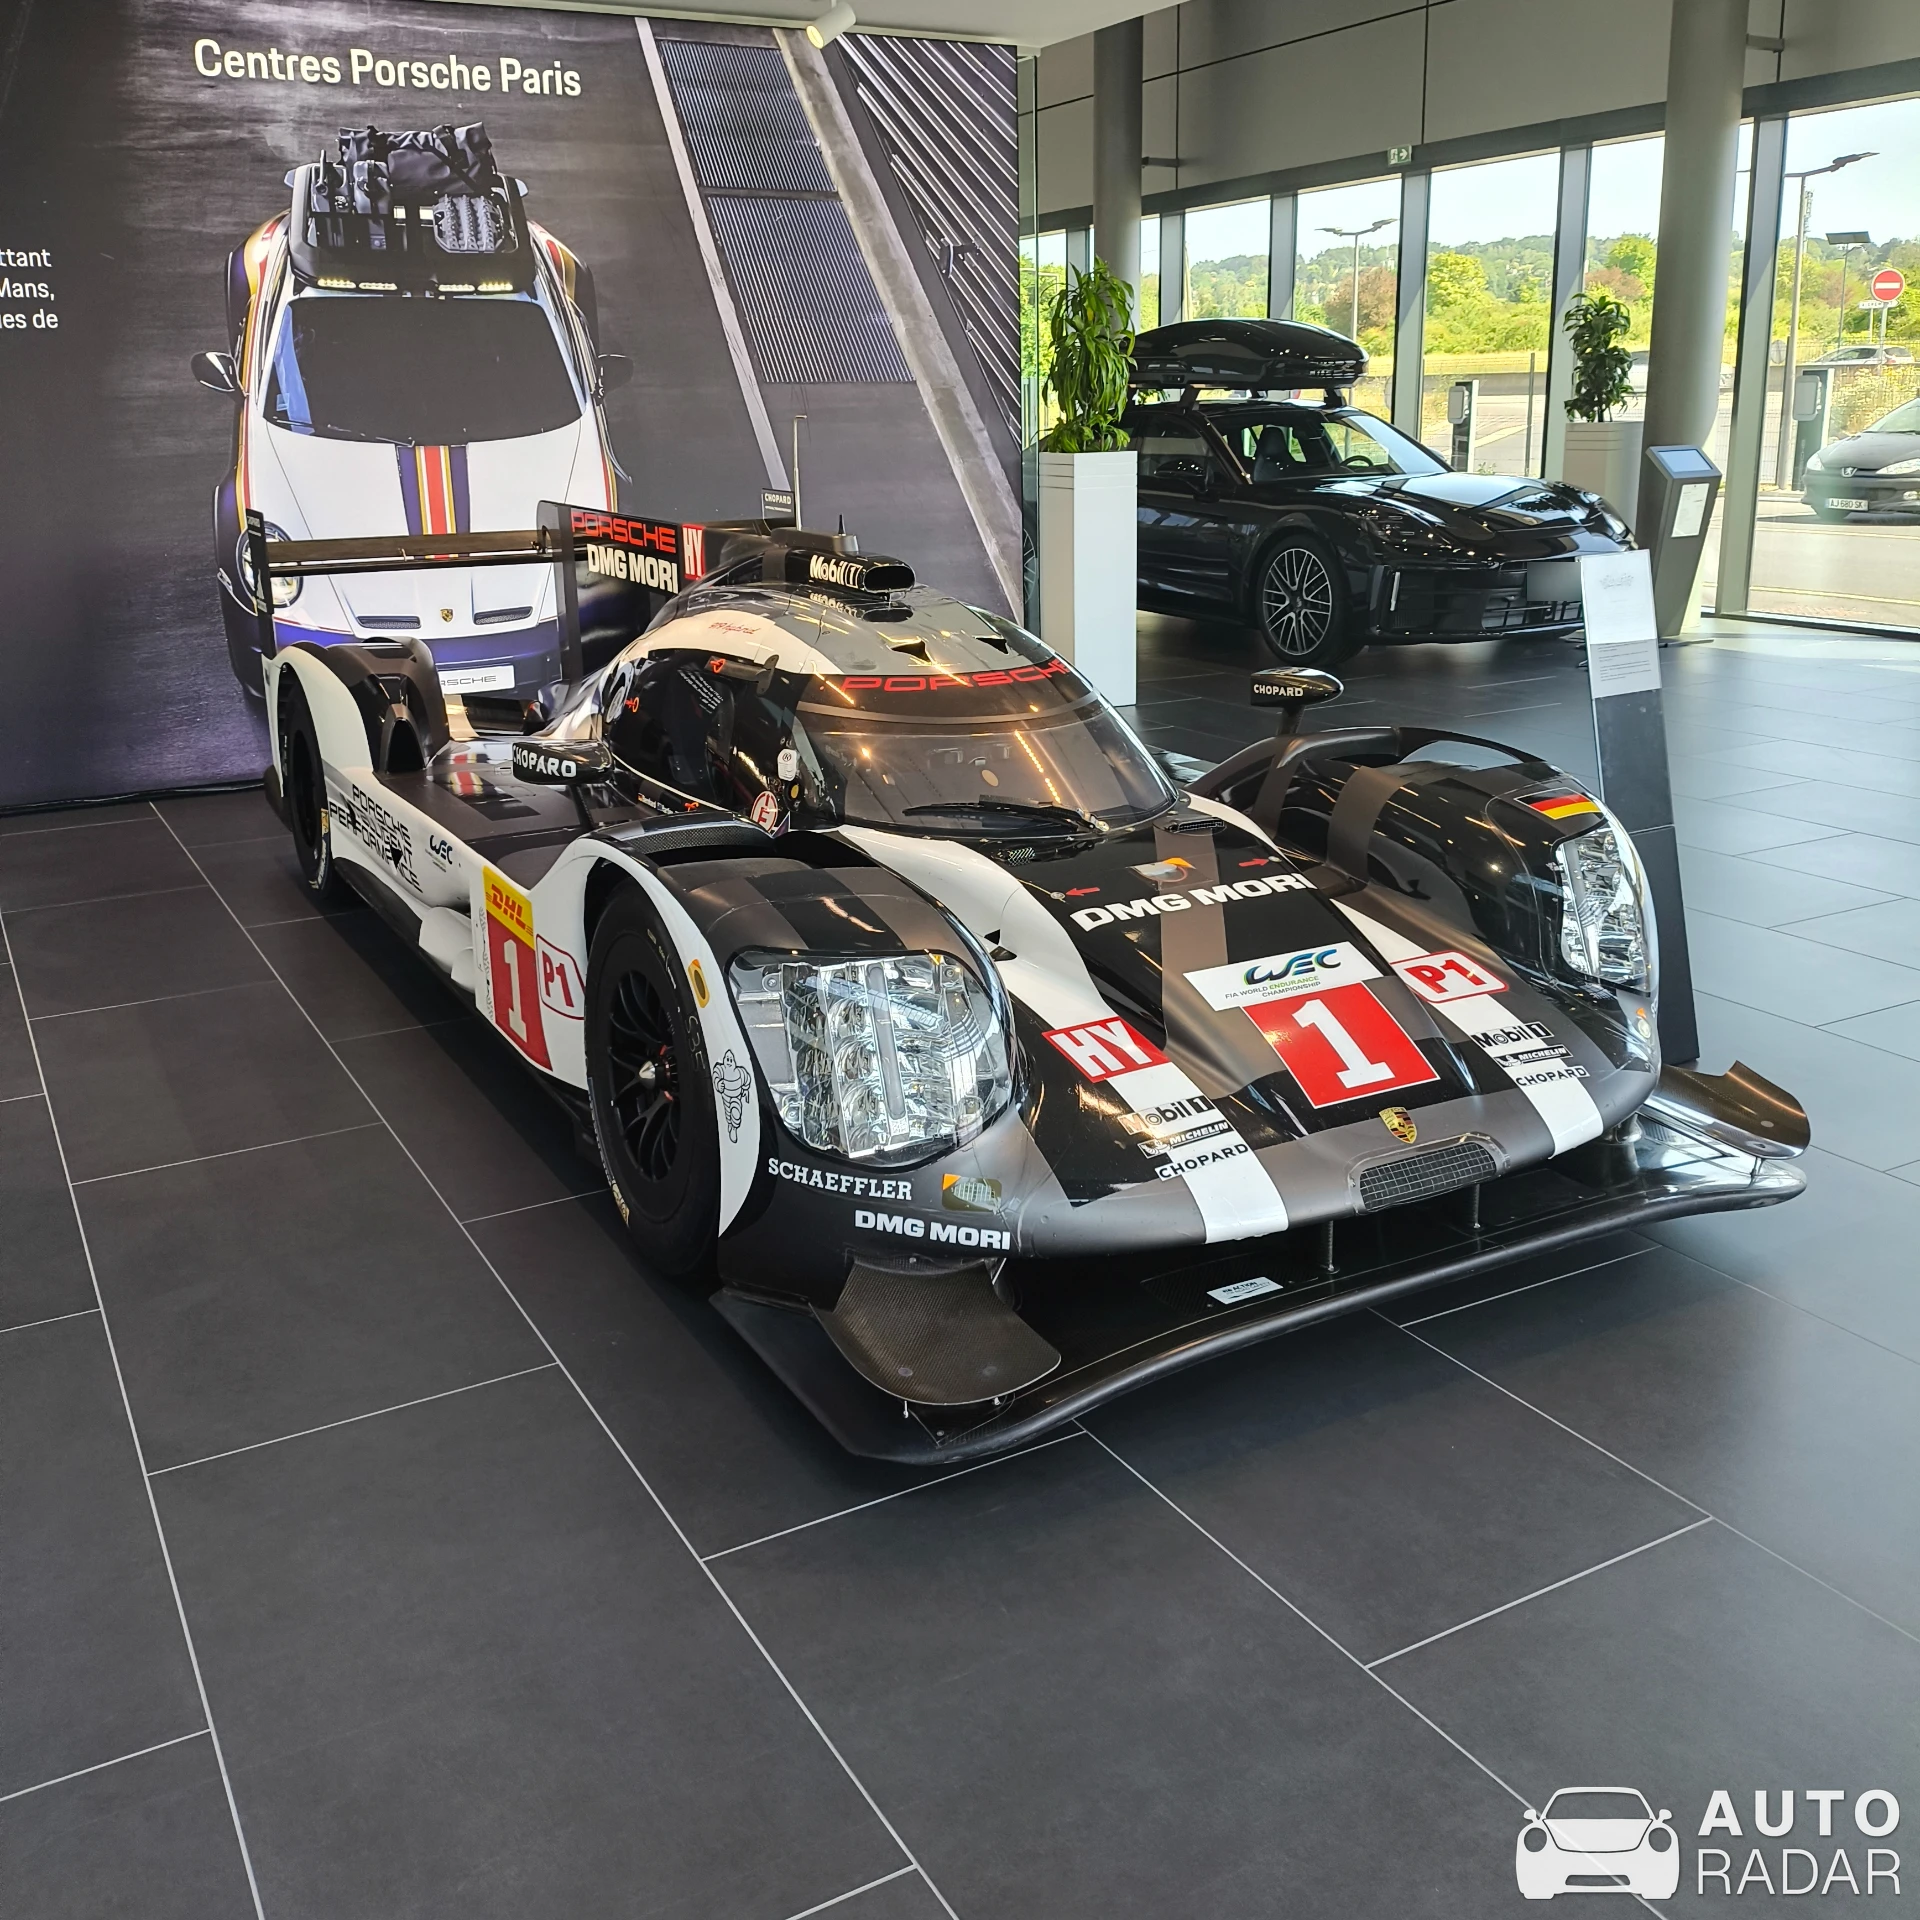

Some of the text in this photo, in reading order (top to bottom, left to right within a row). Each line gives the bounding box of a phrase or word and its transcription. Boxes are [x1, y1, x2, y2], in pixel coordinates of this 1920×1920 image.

[193, 38, 582, 97] Centres Porsche Paris
[0, 308, 59, 329] es de
[571, 510, 676, 553] PORSCHE
[586, 543, 679, 594] DMG MORI
[682, 527, 703, 577] HY
[810, 554, 848, 585] Mobil
[841, 659, 1070, 692] PORSCHE
[1253, 684, 1304, 697] CHOPARD
[352, 784, 412, 848] PORSCHE
[490, 883, 526, 931] DHL
[1069, 873, 1318, 932] DMG MORI
[541, 950, 575, 1008] P1
[1240, 986, 1268, 996] WORLD
[1269, 975, 1320, 990] ENDURANCE
[1243, 948, 1341, 986] WEC
[1404, 959, 1487, 994] P1
[503, 938, 527, 1043] 1
[1261, 981, 1321, 998] CHAMPIONSHIP
[1049, 1019, 1152, 1078] HY
[1291, 998, 1396, 1089] 1
[1471, 1024, 1533, 1048] Mobil
[1518, 1047, 1567, 1062] MICHELIN
[1515, 1067, 1587, 1087] CHOPARD
[1118, 1101, 1192, 1134] Mobil
[1168, 1121, 1229, 1145] MICHELIN
[767, 1157, 912, 1201] SCHAEFFLER
[1159, 1143, 1249, 1179] CHOPARD
[854, 1209, 1011, 1250] DMG MORI
